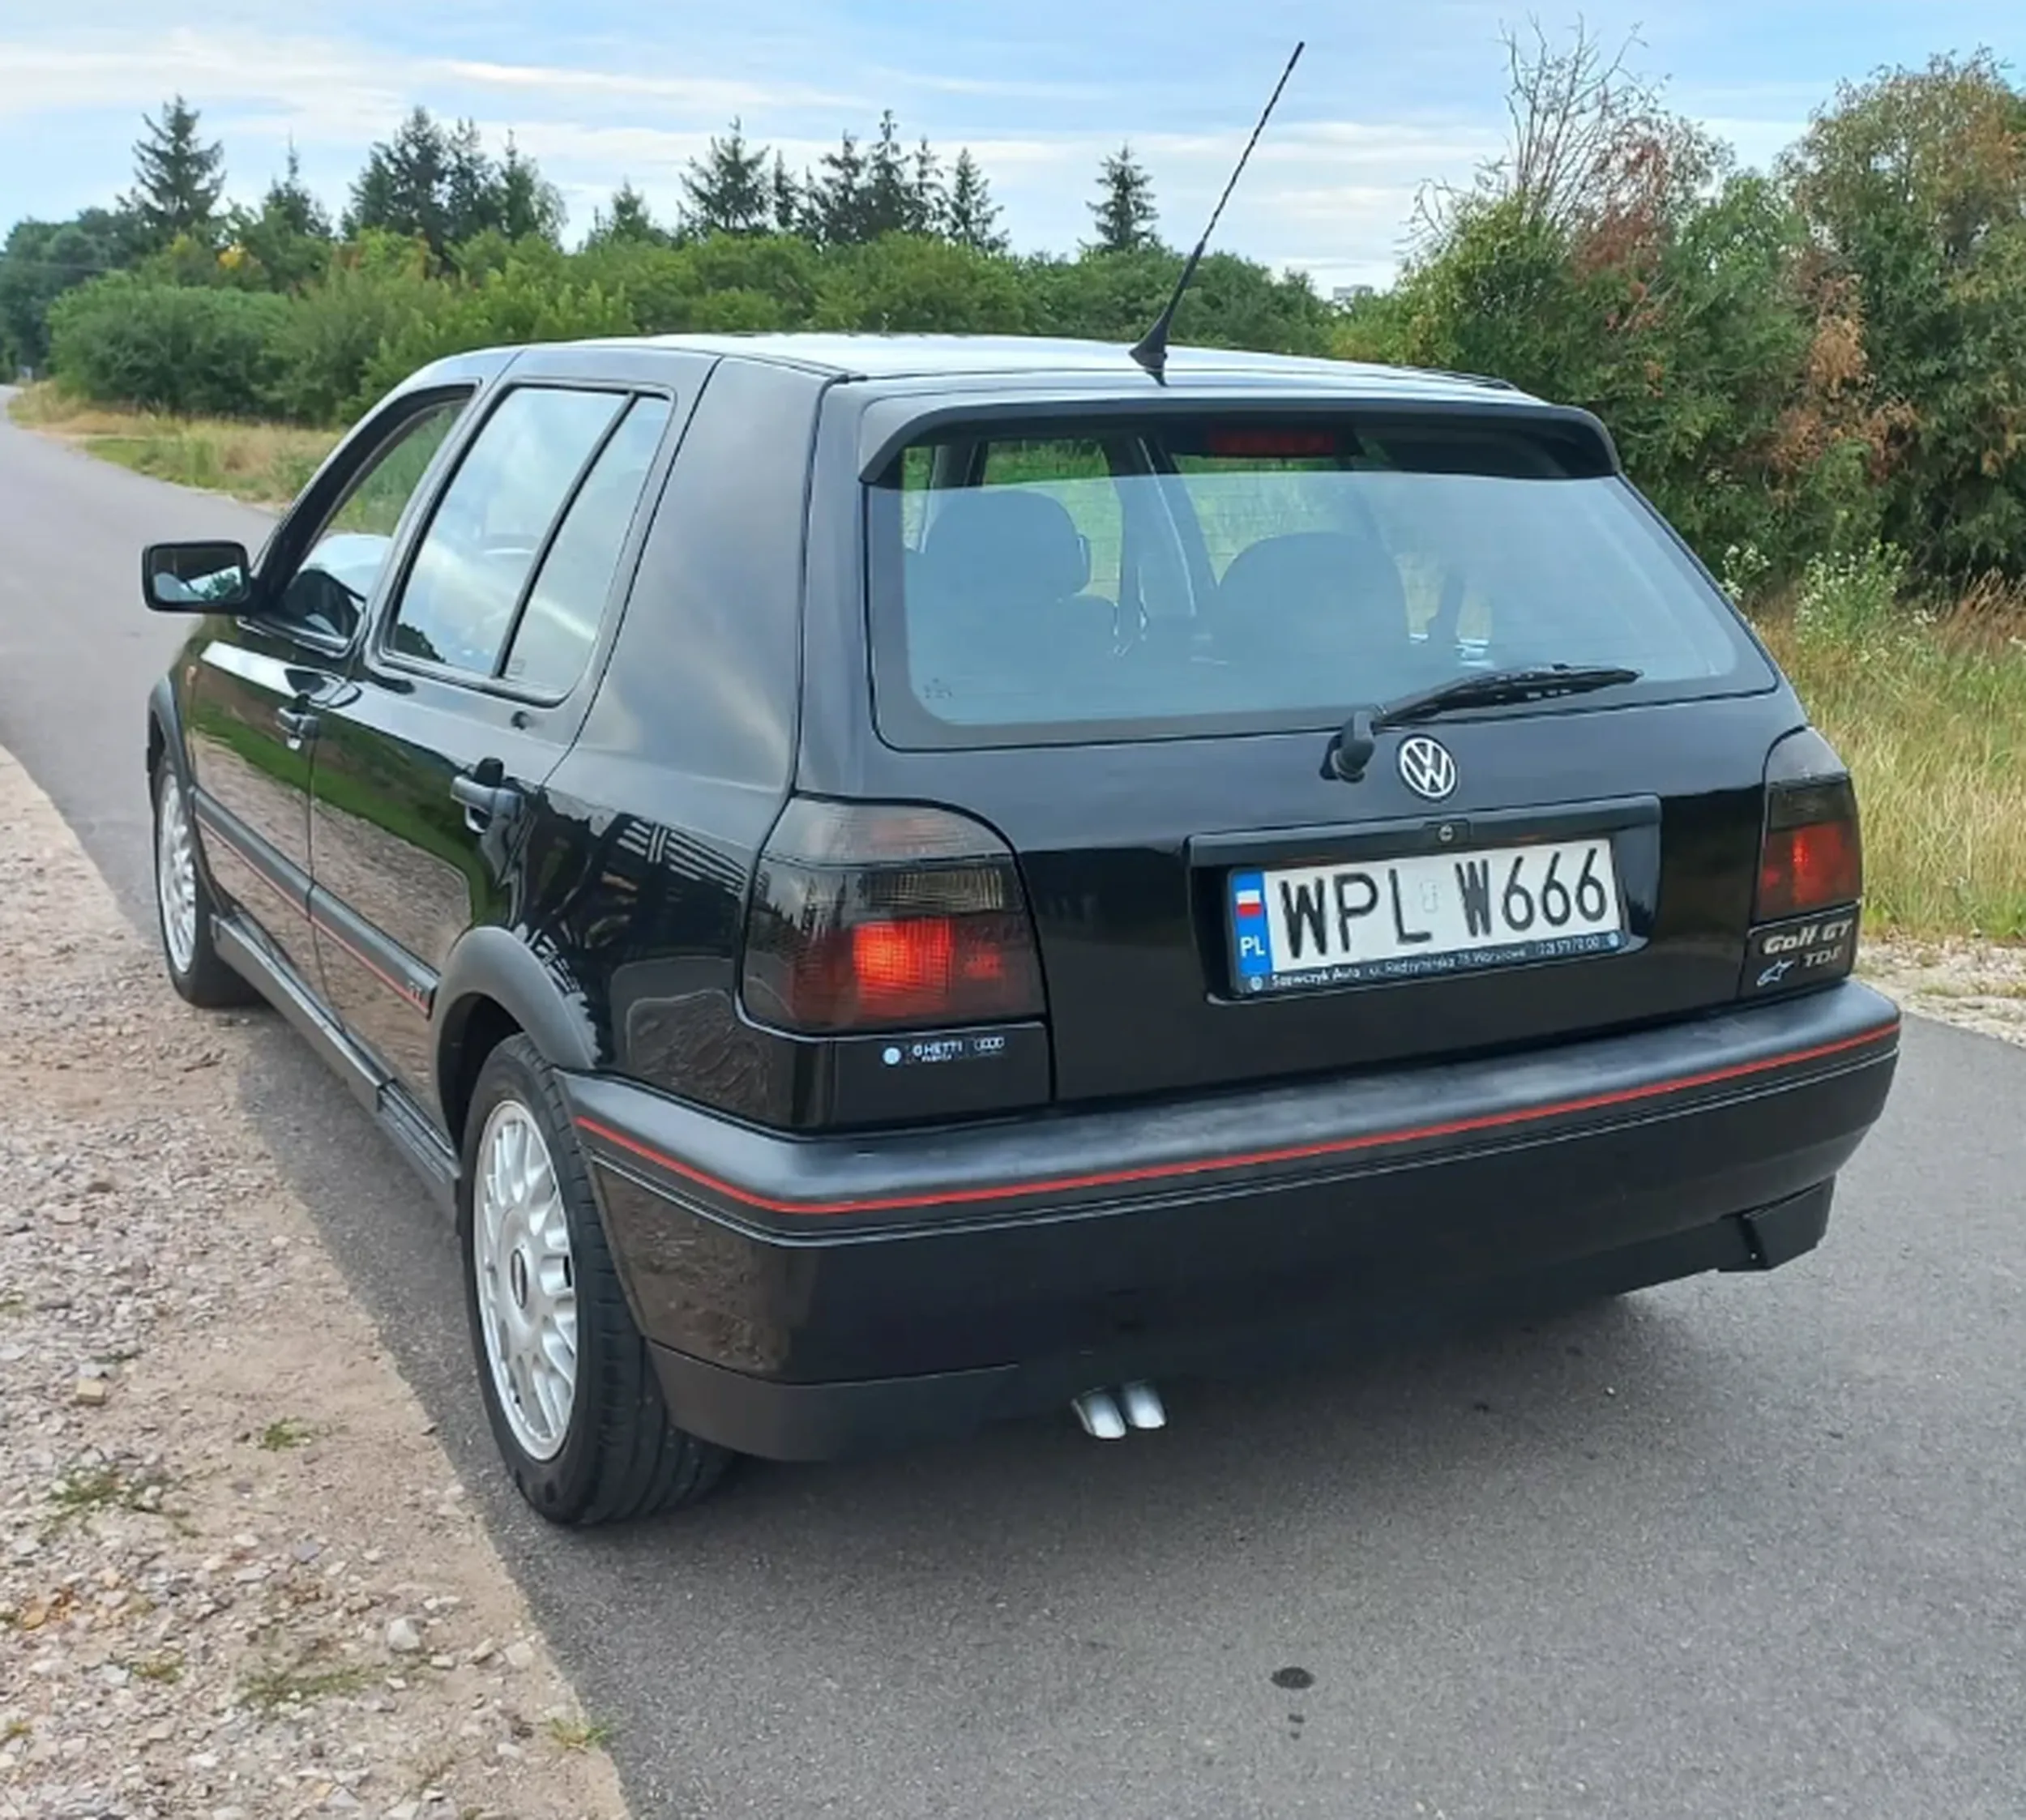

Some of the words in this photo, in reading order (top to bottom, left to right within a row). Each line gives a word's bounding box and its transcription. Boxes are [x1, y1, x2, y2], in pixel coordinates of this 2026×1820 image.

[1400, 737, 1455, 797] VW
[1277, 868, 1432, 959] WPL
[1455, 847, 1607, 938] W666
[1240, 936, 1266, 958] PL
[1762, 924, 1819, 955] Golf
